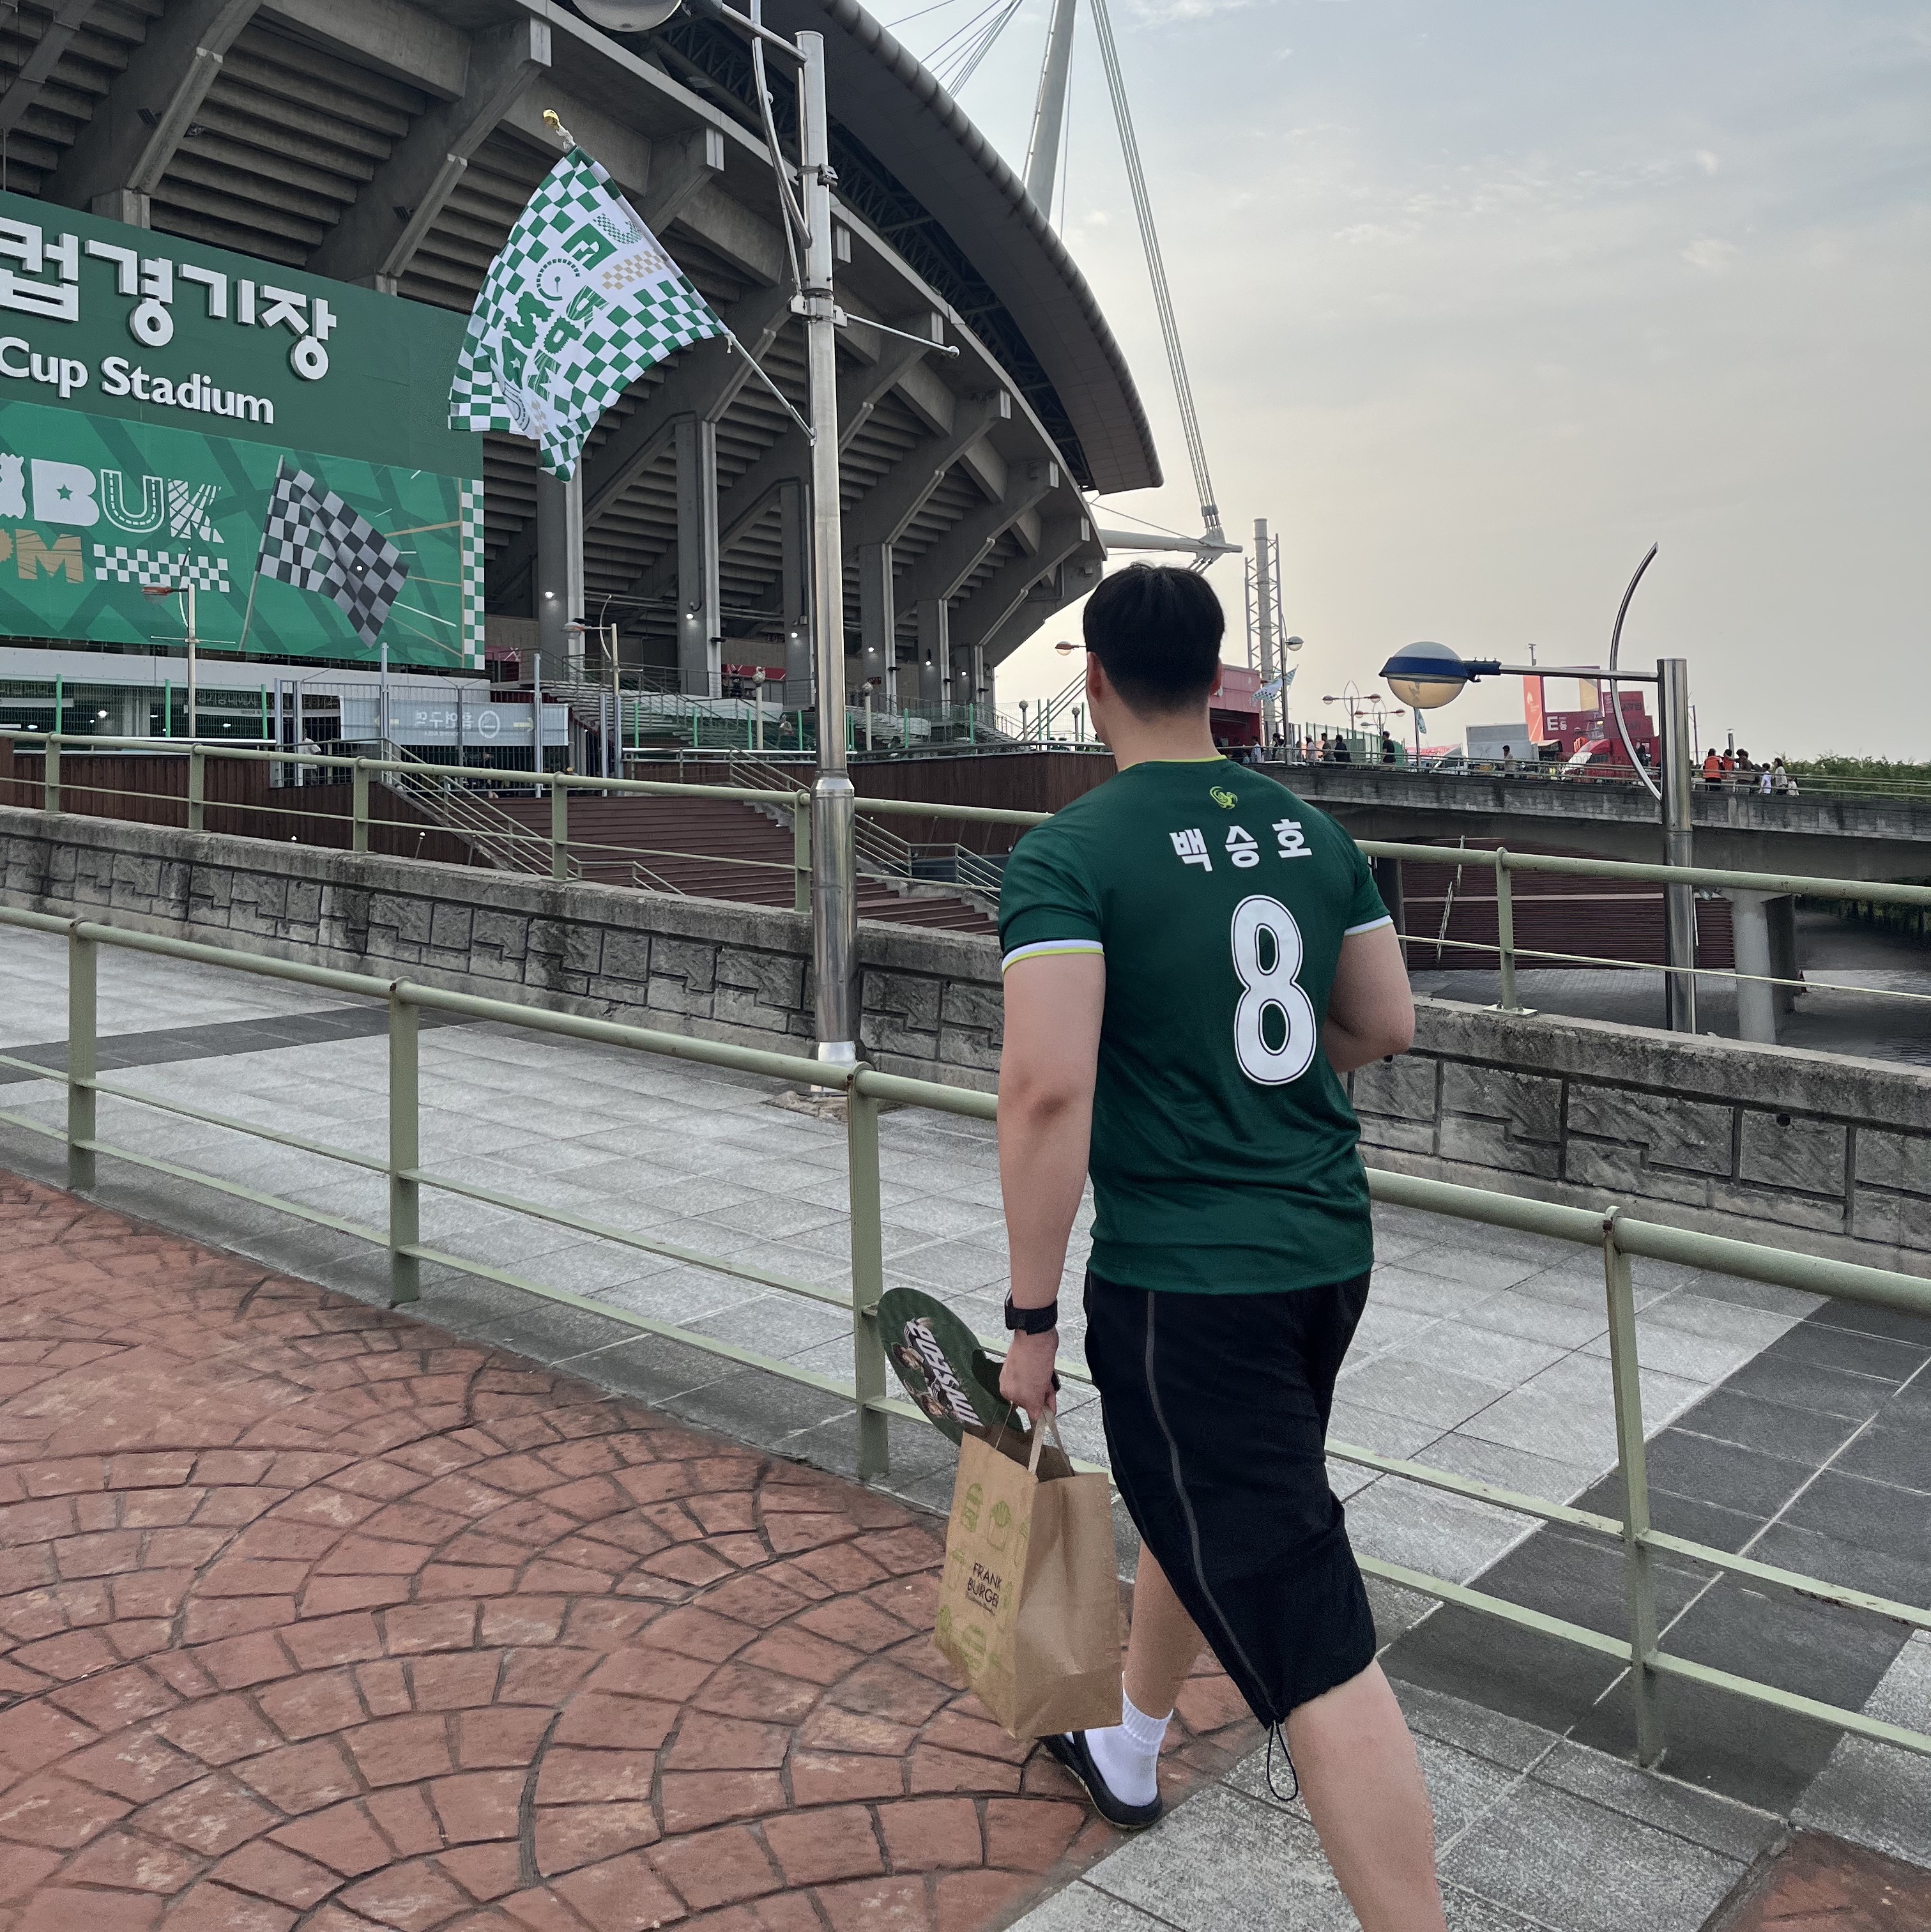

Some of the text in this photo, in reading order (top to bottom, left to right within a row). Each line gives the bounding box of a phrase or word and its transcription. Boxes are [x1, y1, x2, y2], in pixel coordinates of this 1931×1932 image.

[0, 336, 274, 425] Cup Stadium
[1168, 818, 1313, 872] 백승호
[1230, 894, 1317, 1086] 8
[972, 1561, 1003, 1591] FRANK
